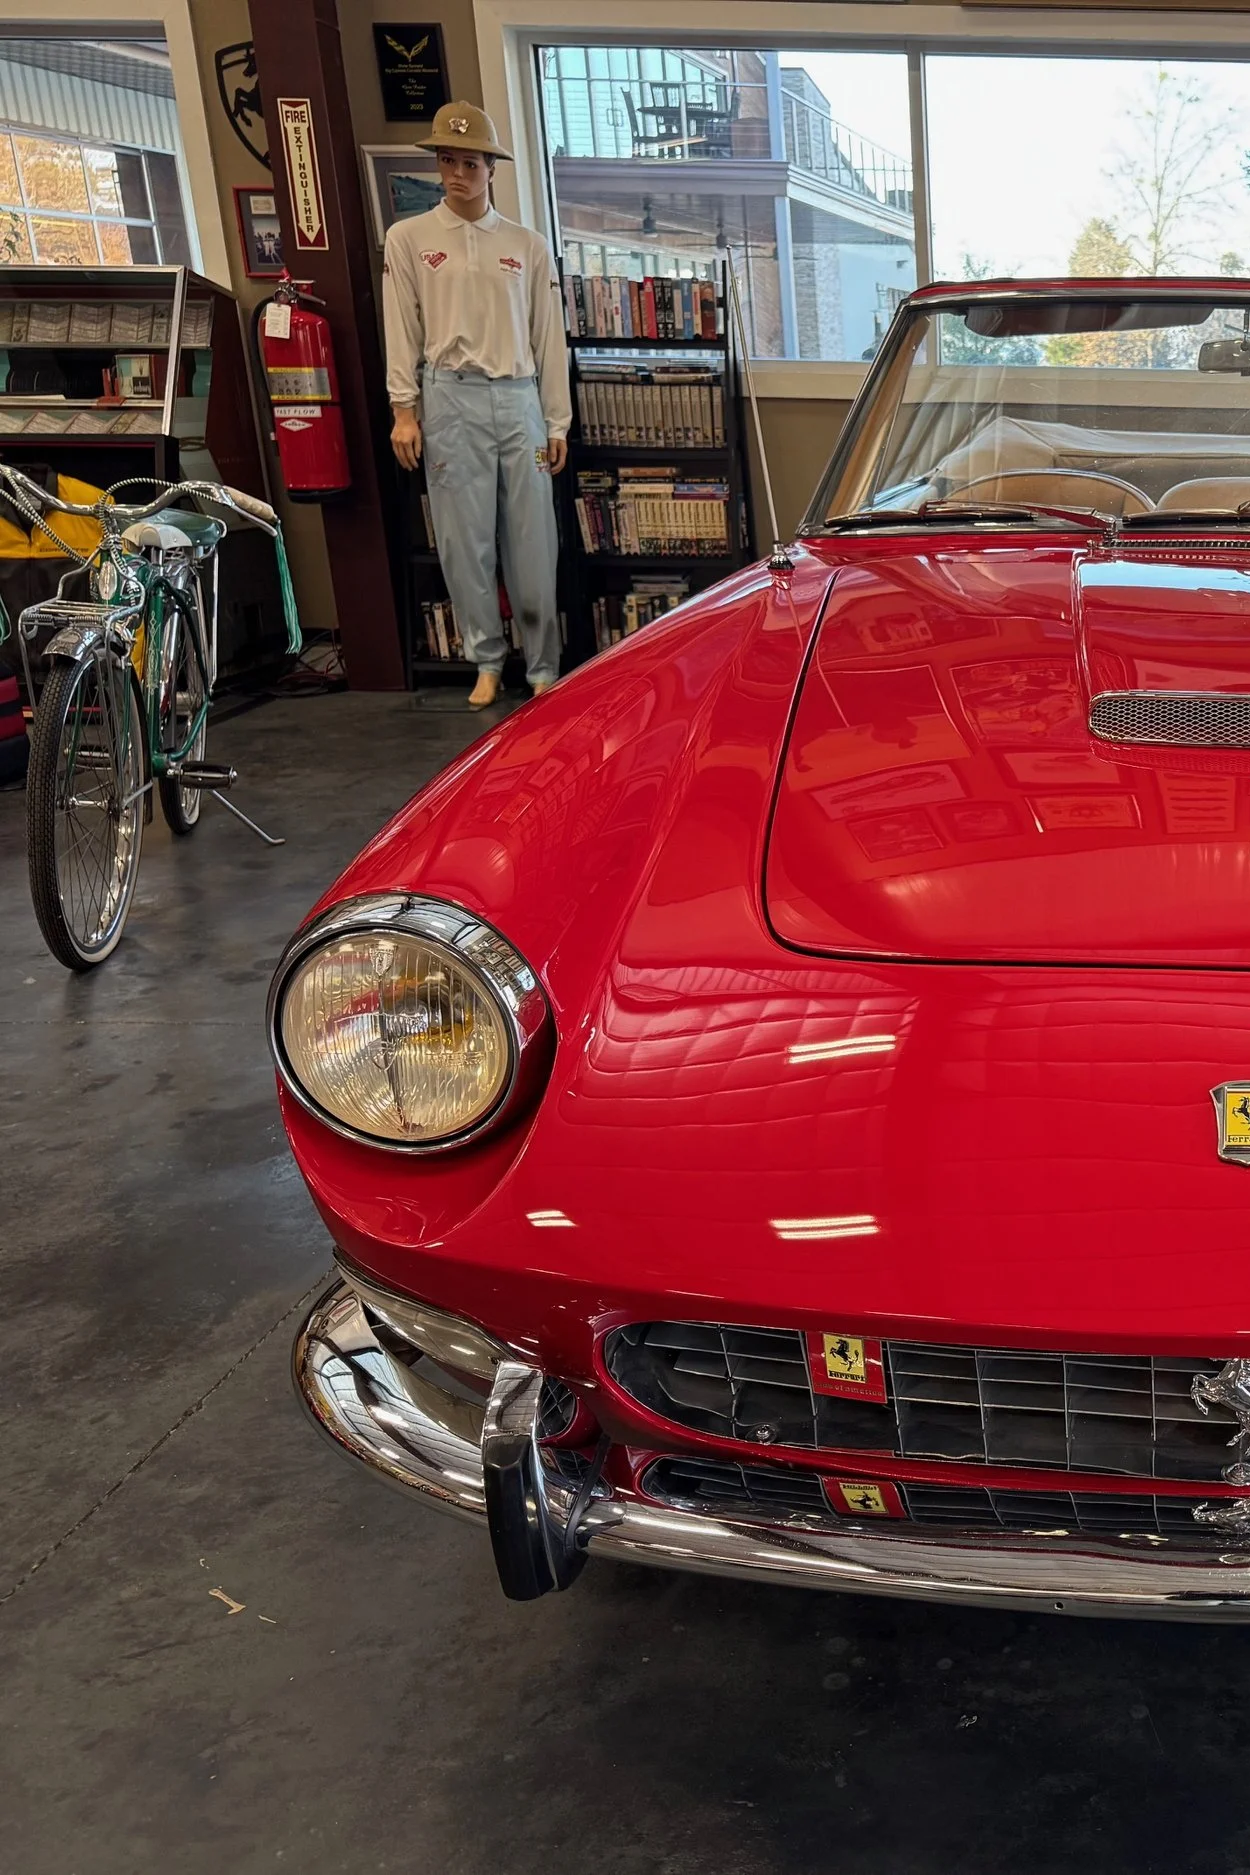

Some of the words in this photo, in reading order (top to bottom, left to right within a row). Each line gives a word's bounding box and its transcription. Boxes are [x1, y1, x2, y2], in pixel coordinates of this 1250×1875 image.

[285, 110, 307, 123] FIRE
[293, 126, 314, 233] EXTINGUISHER
[828, 1370, 866, 1381] Ferrari
